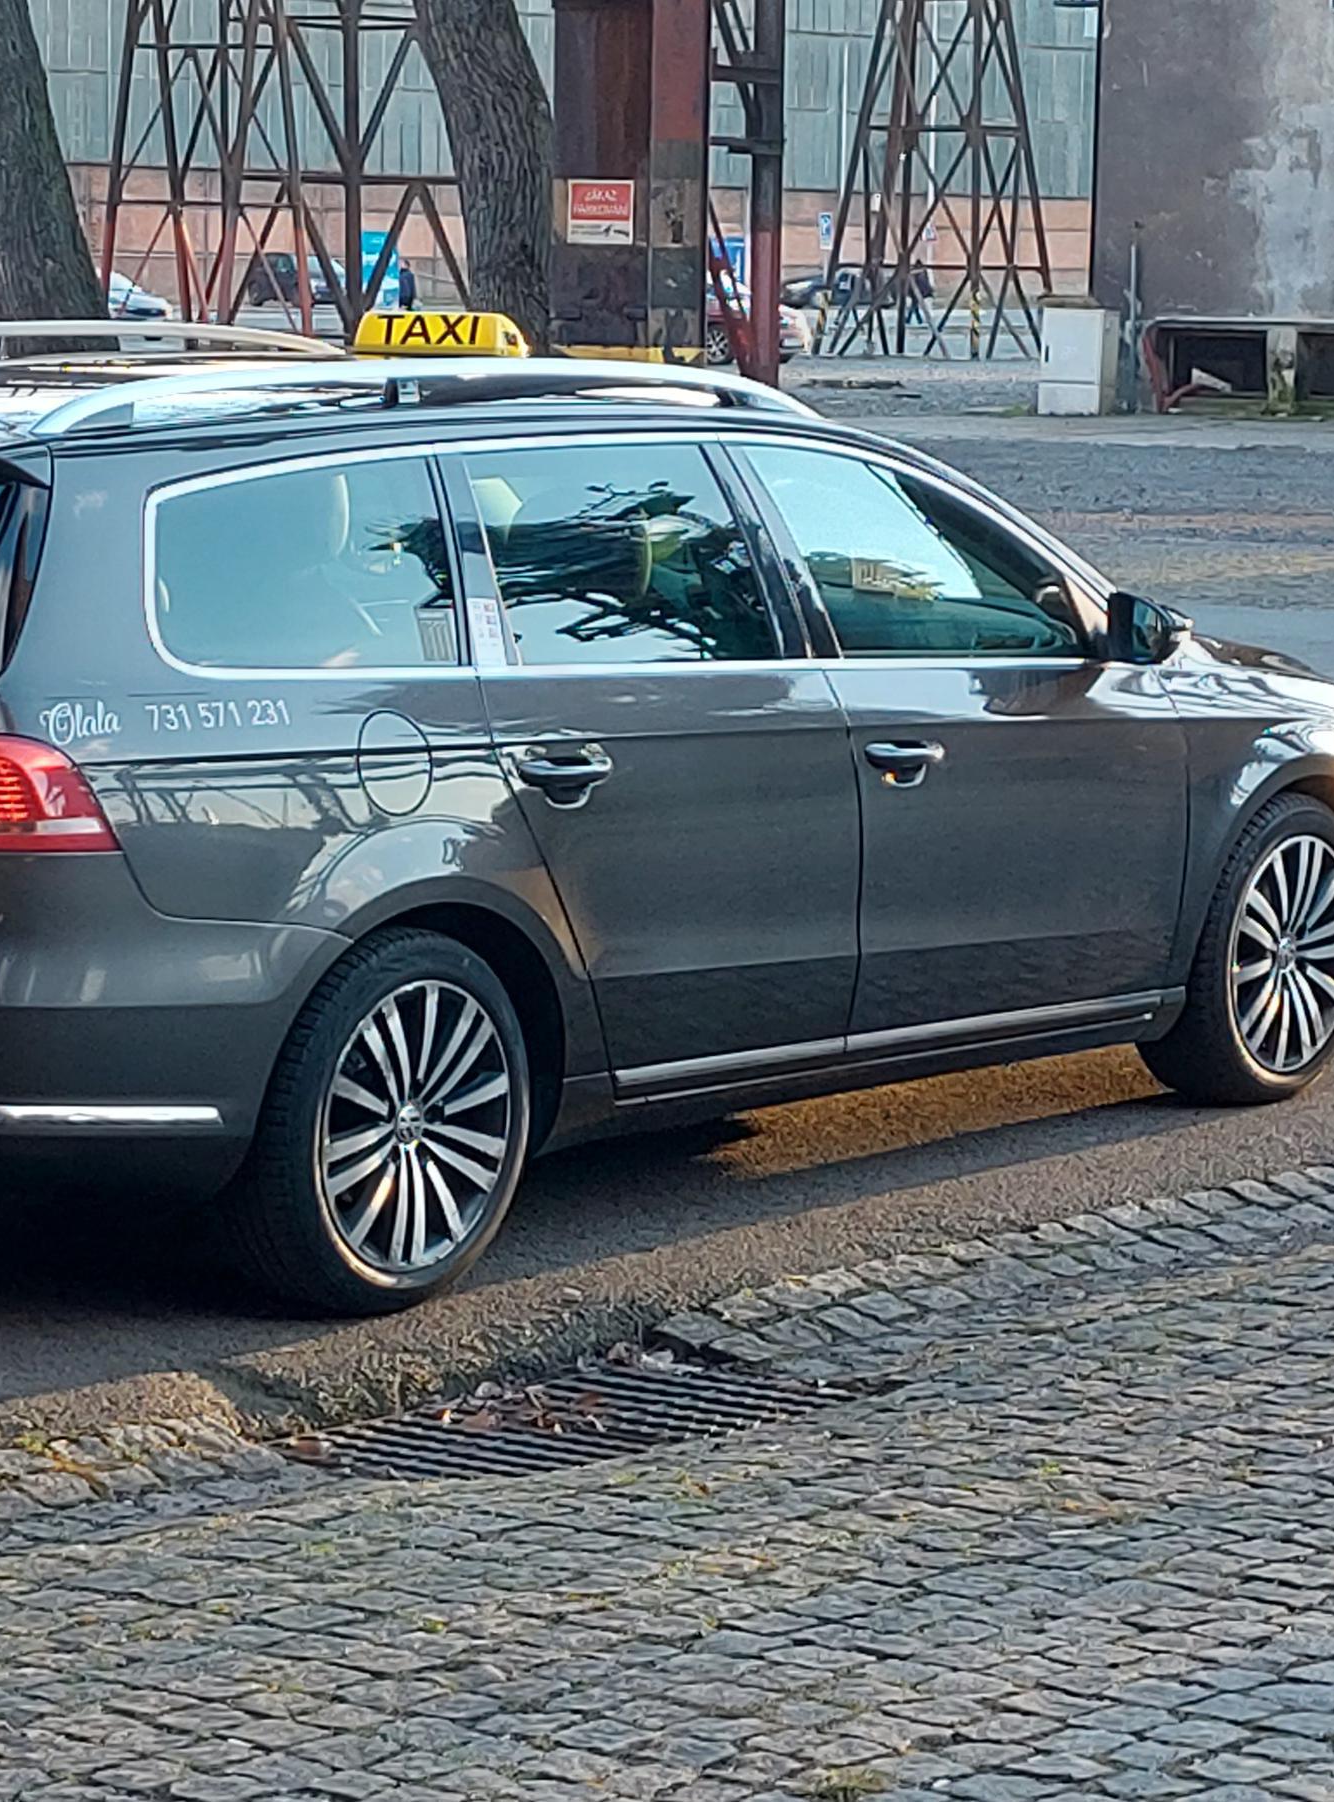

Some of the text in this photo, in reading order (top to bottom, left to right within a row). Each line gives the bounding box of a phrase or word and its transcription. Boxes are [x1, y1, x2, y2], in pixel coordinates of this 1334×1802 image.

[377, 314, 480, 346] TAXI
[39, 699, 291, 746] Olala 731 571 231
